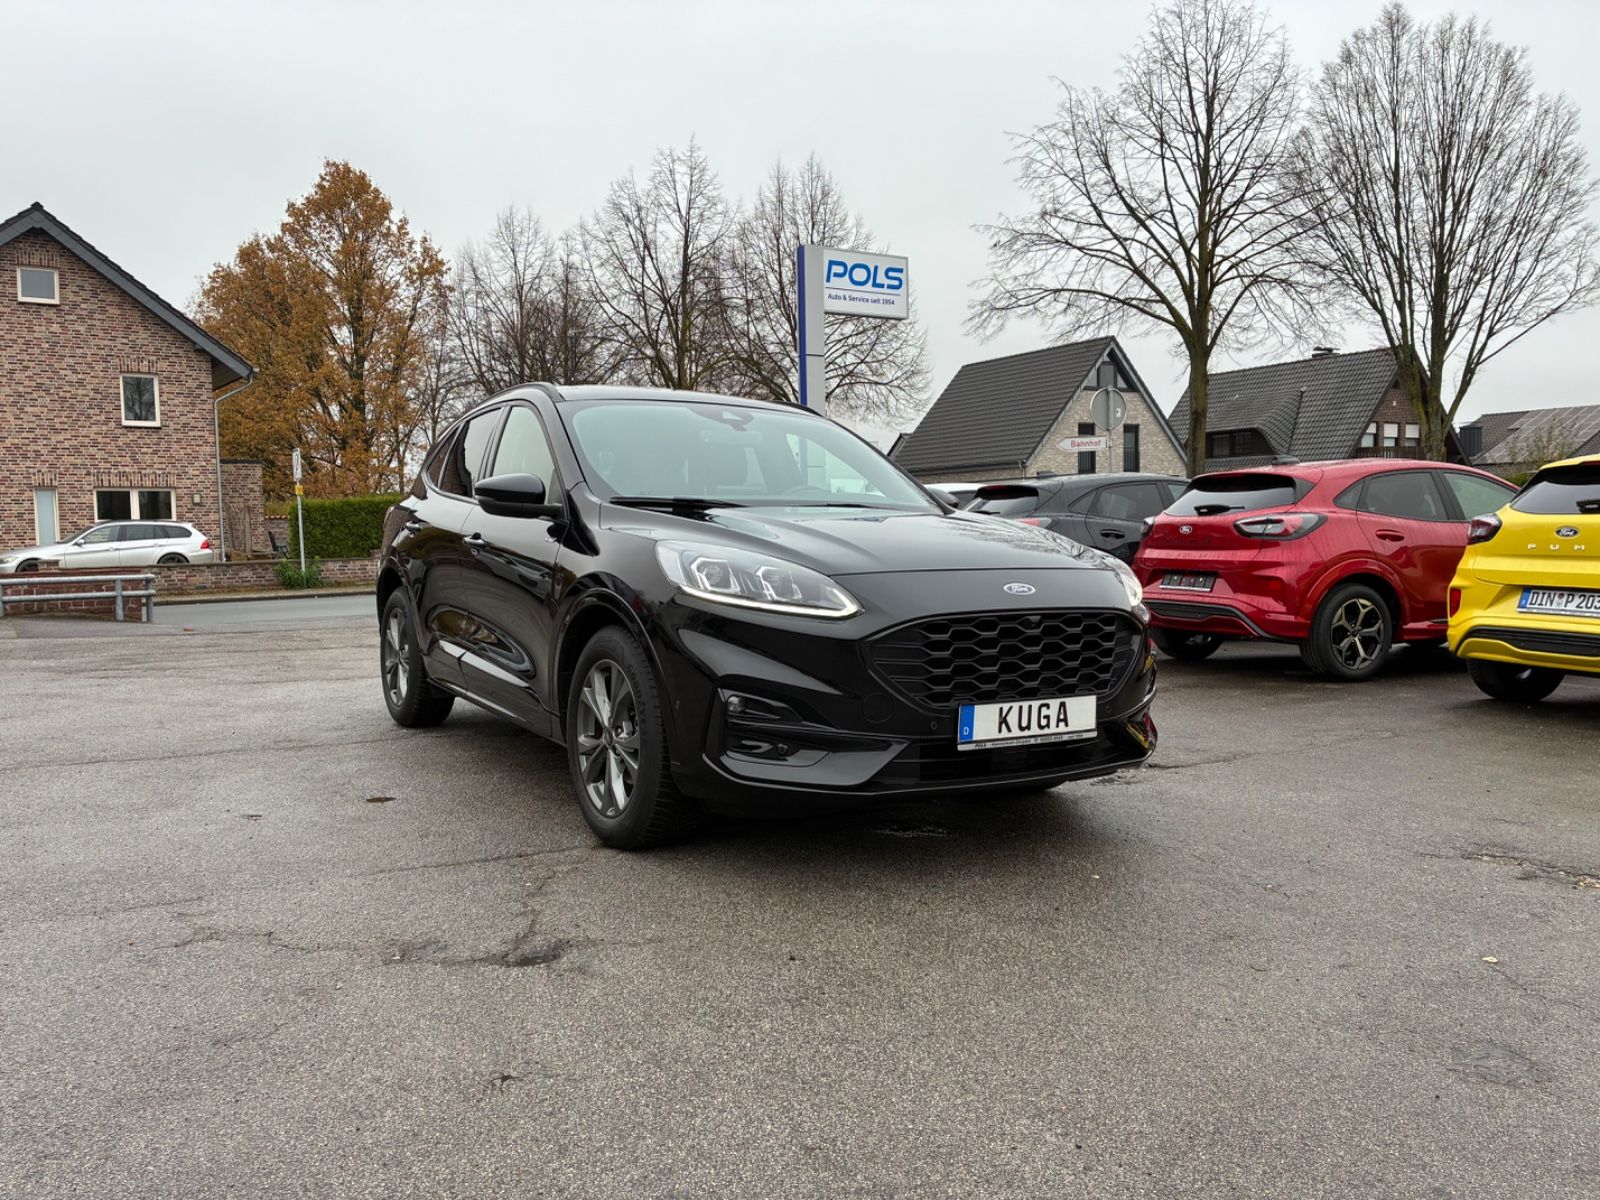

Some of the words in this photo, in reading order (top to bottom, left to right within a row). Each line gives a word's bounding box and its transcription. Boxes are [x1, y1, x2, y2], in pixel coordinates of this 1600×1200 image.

[826, 259, 904, 290] POLS
[848, 295, 869, 303] Service
[1070, 440, 1101, 448] Bahnhof
[1529, 591, 1557, 607] DIN
[1564, 593, 1575, 608] P
[998, 701, 1069, 734] KUGA
